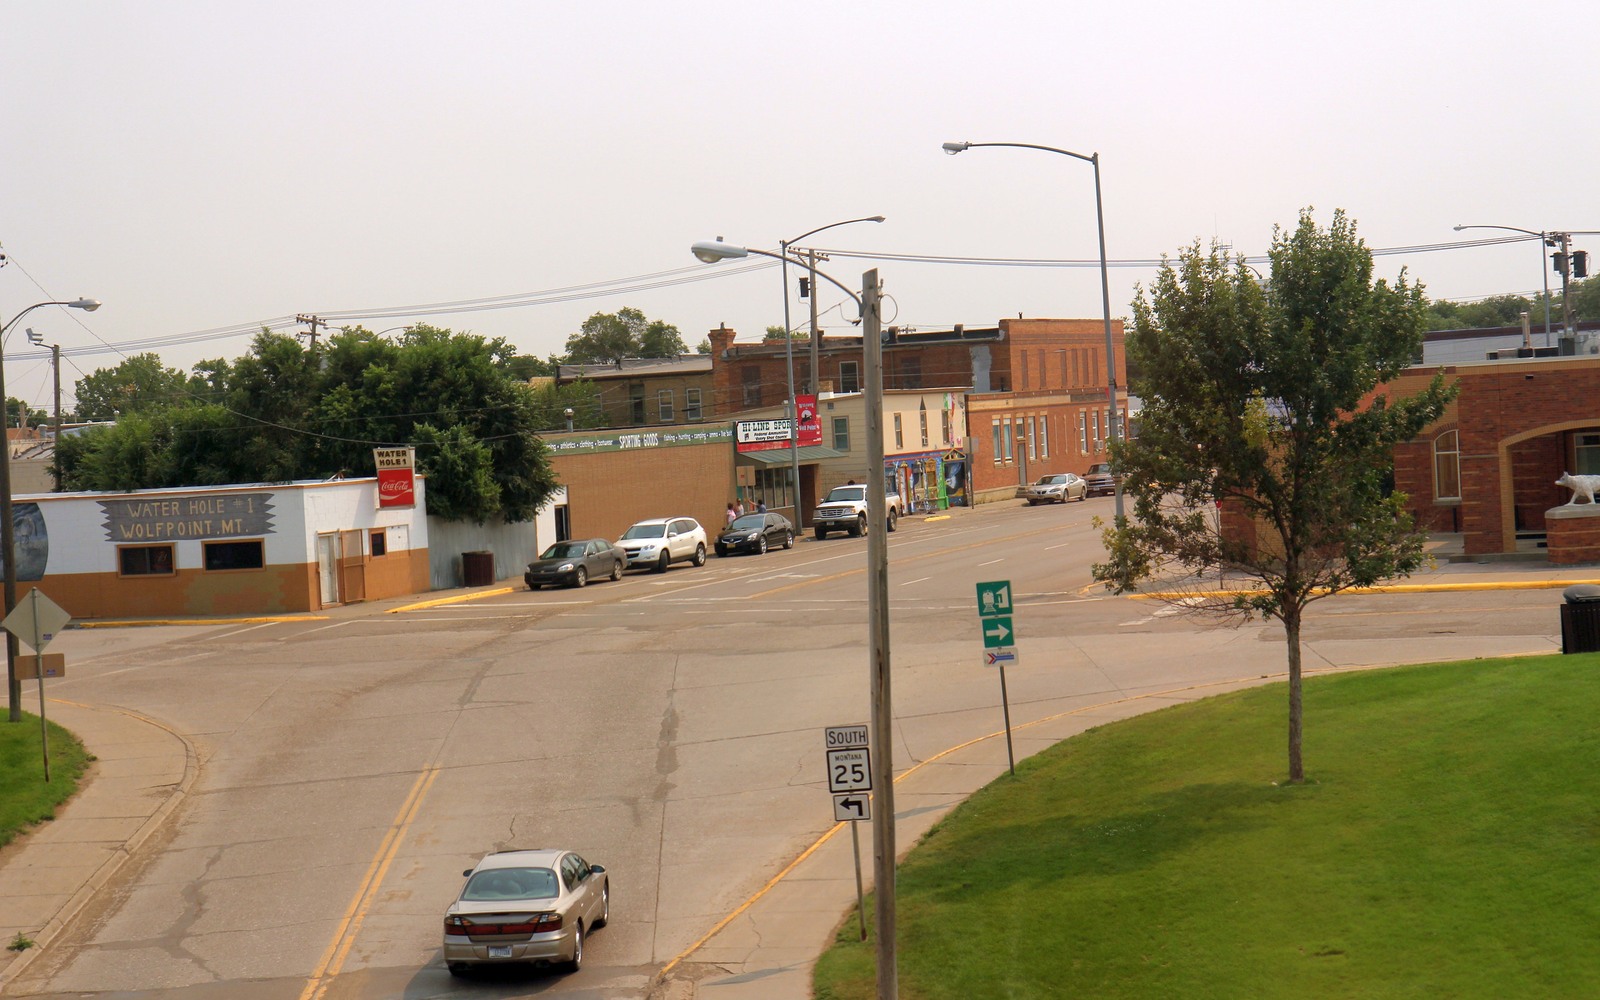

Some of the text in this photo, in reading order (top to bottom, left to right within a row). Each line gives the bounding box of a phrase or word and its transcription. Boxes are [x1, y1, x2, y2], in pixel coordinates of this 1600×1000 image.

[619, 433, 659, 449] SPORTING GOODS
[379, 458, 401, 466] HOLE
[381, 480, 409, 491] Coca-Cola
[127, 501, 180, 518] WATER
[189, 498, 225, 515] HOLE
[828, 731, 866, 745] SOUTH
[834, 753, 862, 761] MONTANA
[834, 764, 865, 784] 25
